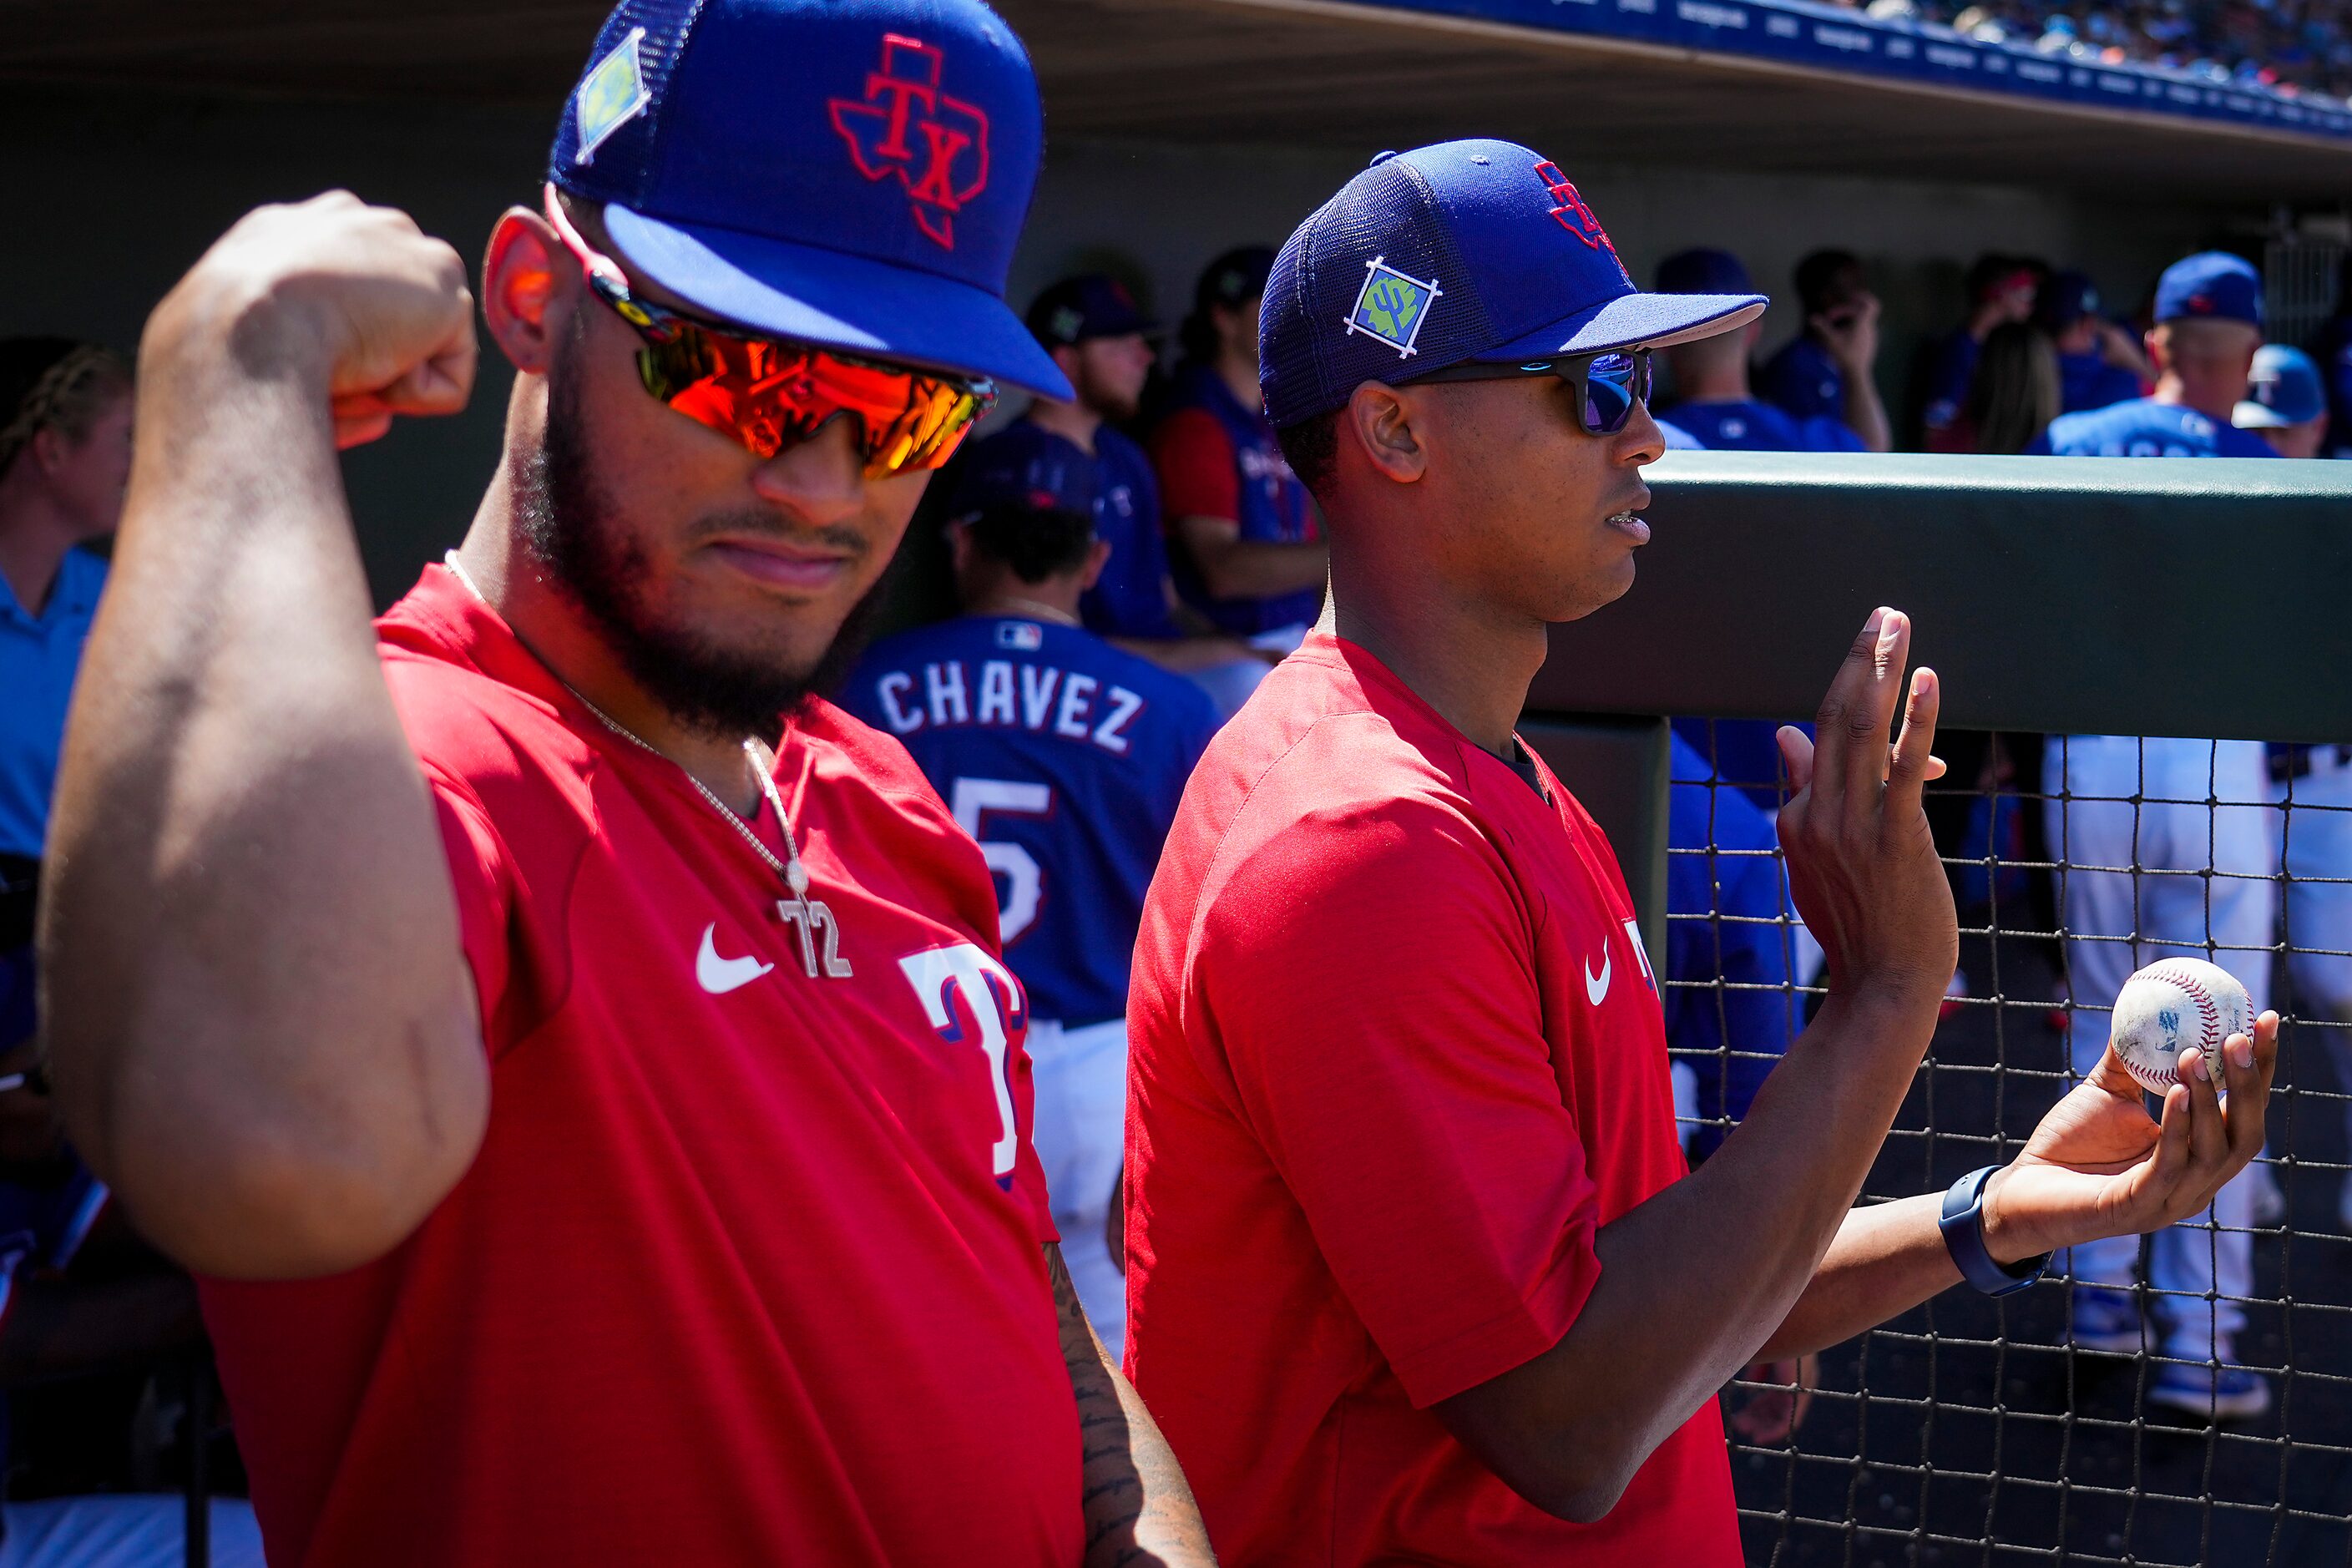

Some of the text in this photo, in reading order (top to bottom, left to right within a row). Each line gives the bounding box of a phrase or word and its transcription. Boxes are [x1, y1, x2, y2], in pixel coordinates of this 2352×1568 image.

[867, 73, 970, 211] TX
[877, 661, 1145, 751] CHAVEZ
[953, 777, 1050, 943] 5
[776, 900, 853, 978] 72
[898, 943, 1028, 1192] T
